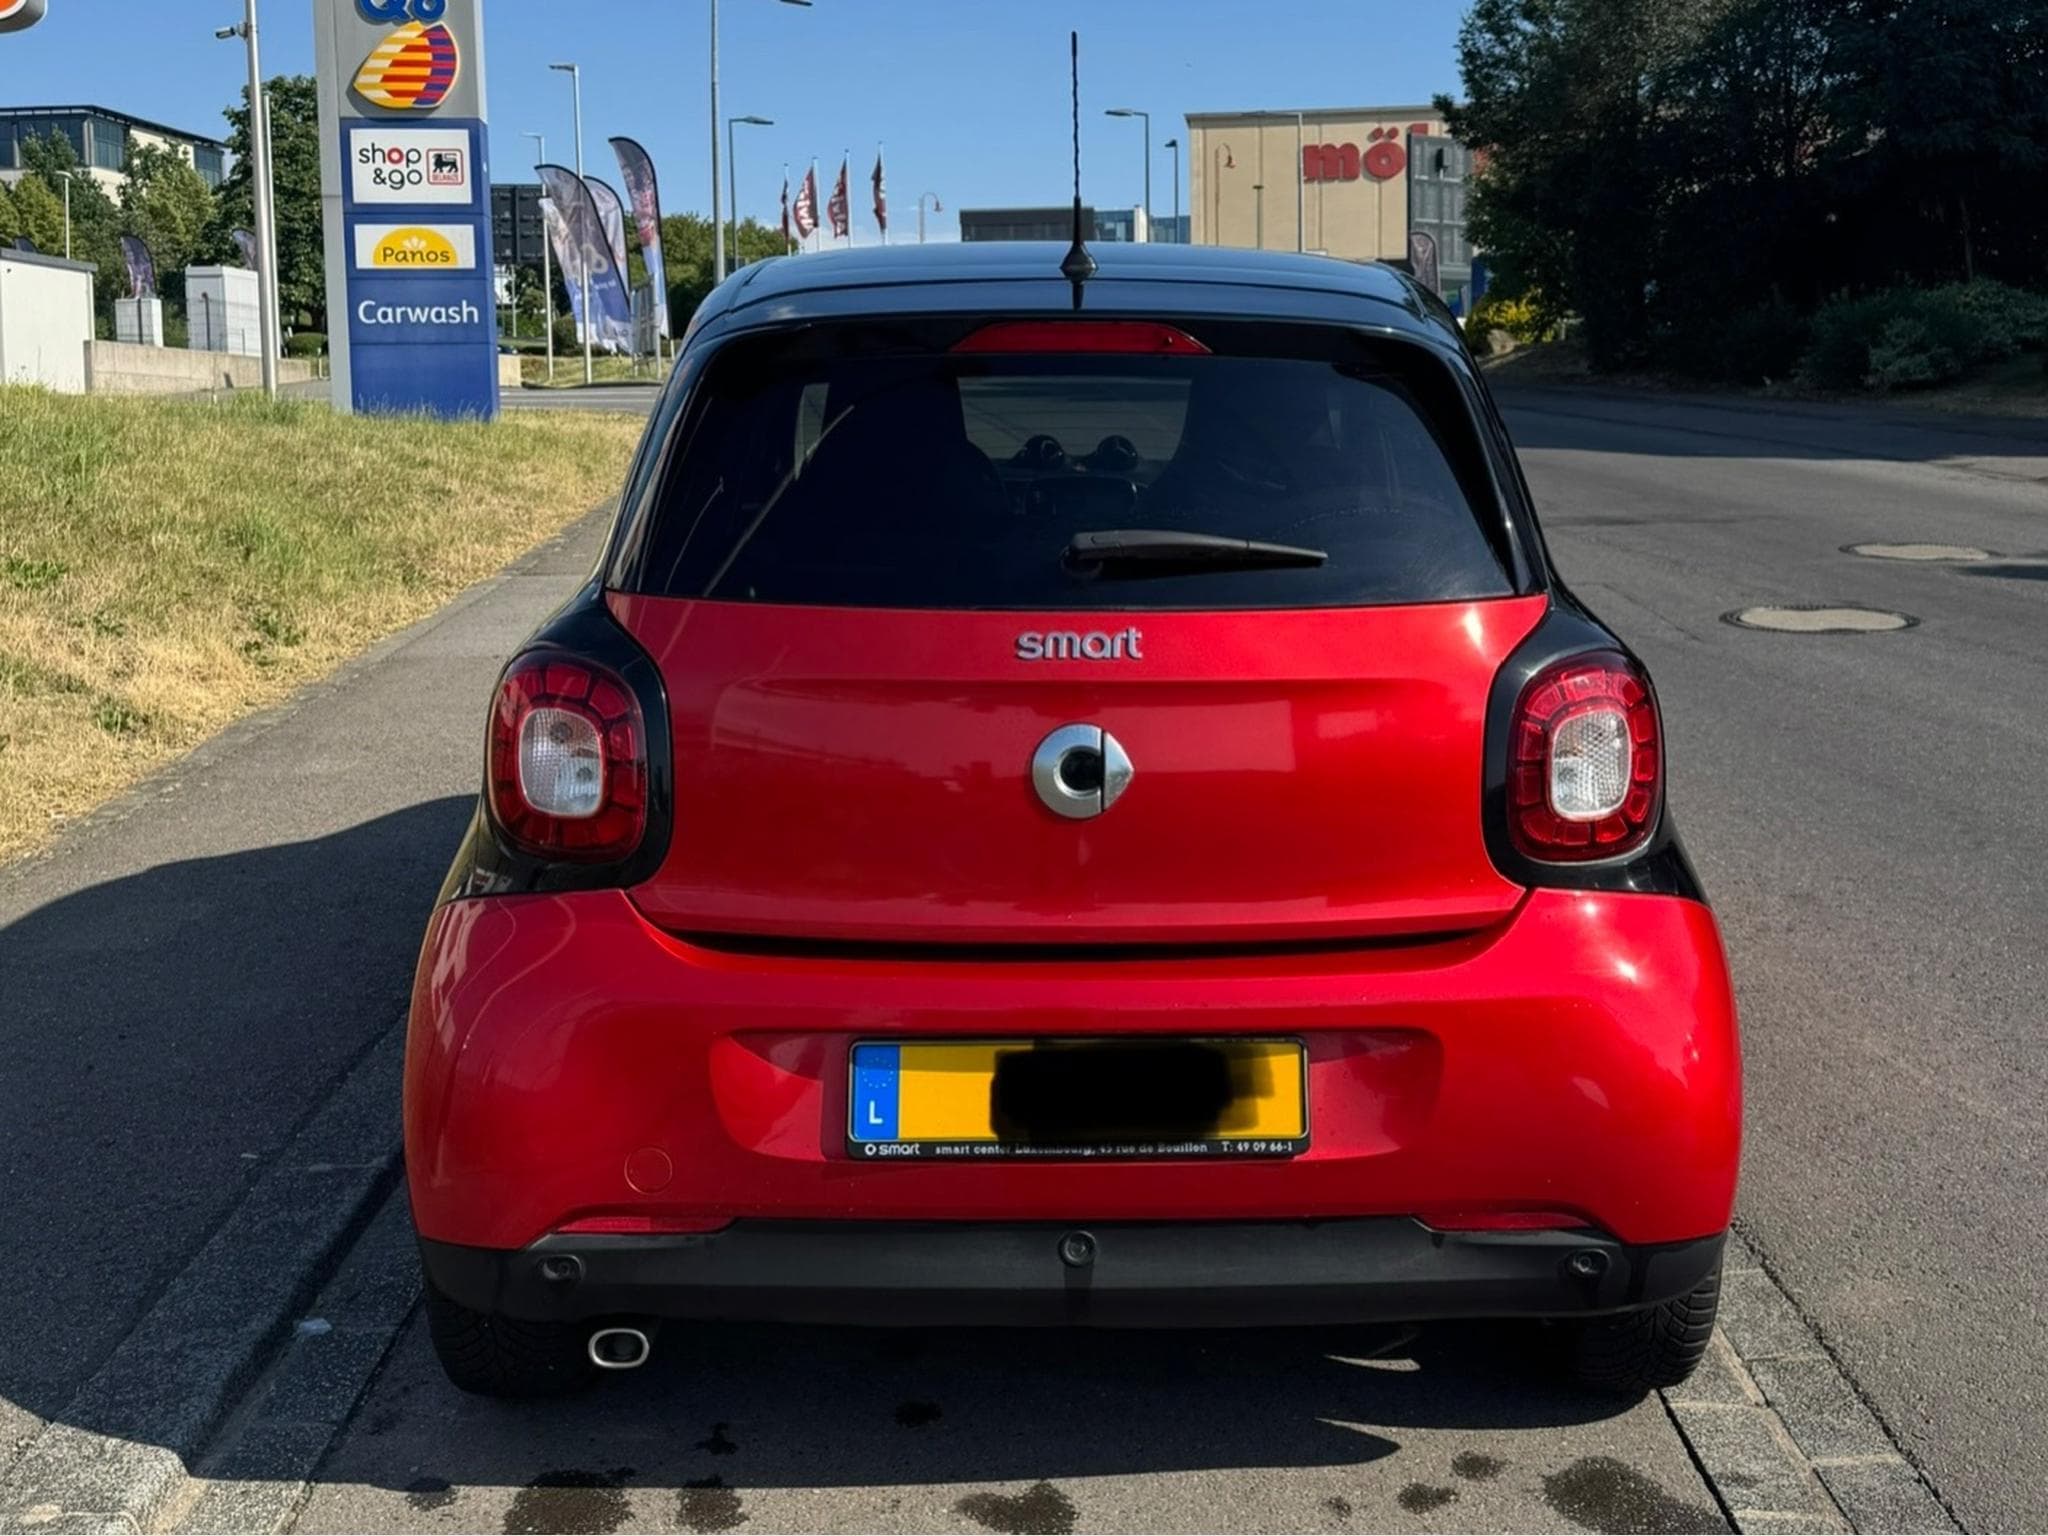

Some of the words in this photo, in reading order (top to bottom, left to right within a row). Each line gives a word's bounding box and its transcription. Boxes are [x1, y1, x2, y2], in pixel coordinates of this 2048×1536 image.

[358, 142, 422, 168] shop
[1303, 123, 1428, 182] mö
[373, 167, 423, 190] &go
[382, 247, 451, 263] Panos
[358, 300, 479, 324] Carwash
[1017, 627, 1143, 660] smart
[869, 1100, 884, 1125] L
[878, 1143, 921, 1156] smart
[935, 1144, 970, 1155] smart
[1116, 1144, 1136, 1154] rue
[1237, 1141, 1250, 1152] 49
[1253, 1141, 1267, 1152] 09
